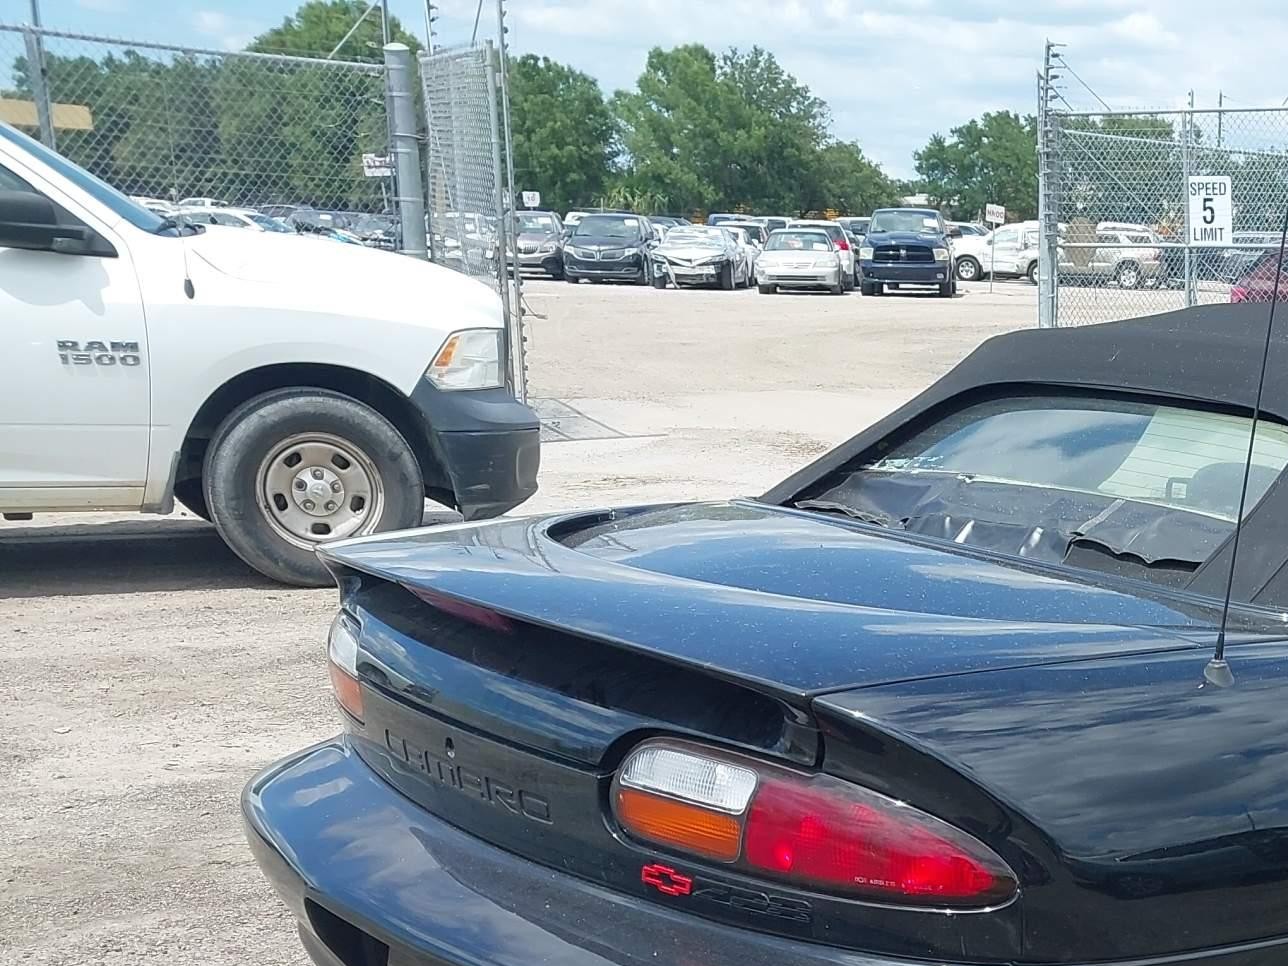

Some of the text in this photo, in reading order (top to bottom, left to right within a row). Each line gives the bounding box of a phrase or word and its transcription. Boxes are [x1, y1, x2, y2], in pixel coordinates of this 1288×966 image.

[1190, 182, 1227, 196] SPEED
[1202, 197, 1215, 225] 5
[1193, 227, 1225, 241] LIMIT
[57, 340, 139, 352] RAM
[58, 353, 141, 366] 1500
[383, 728, 554, 825] CAMARO
